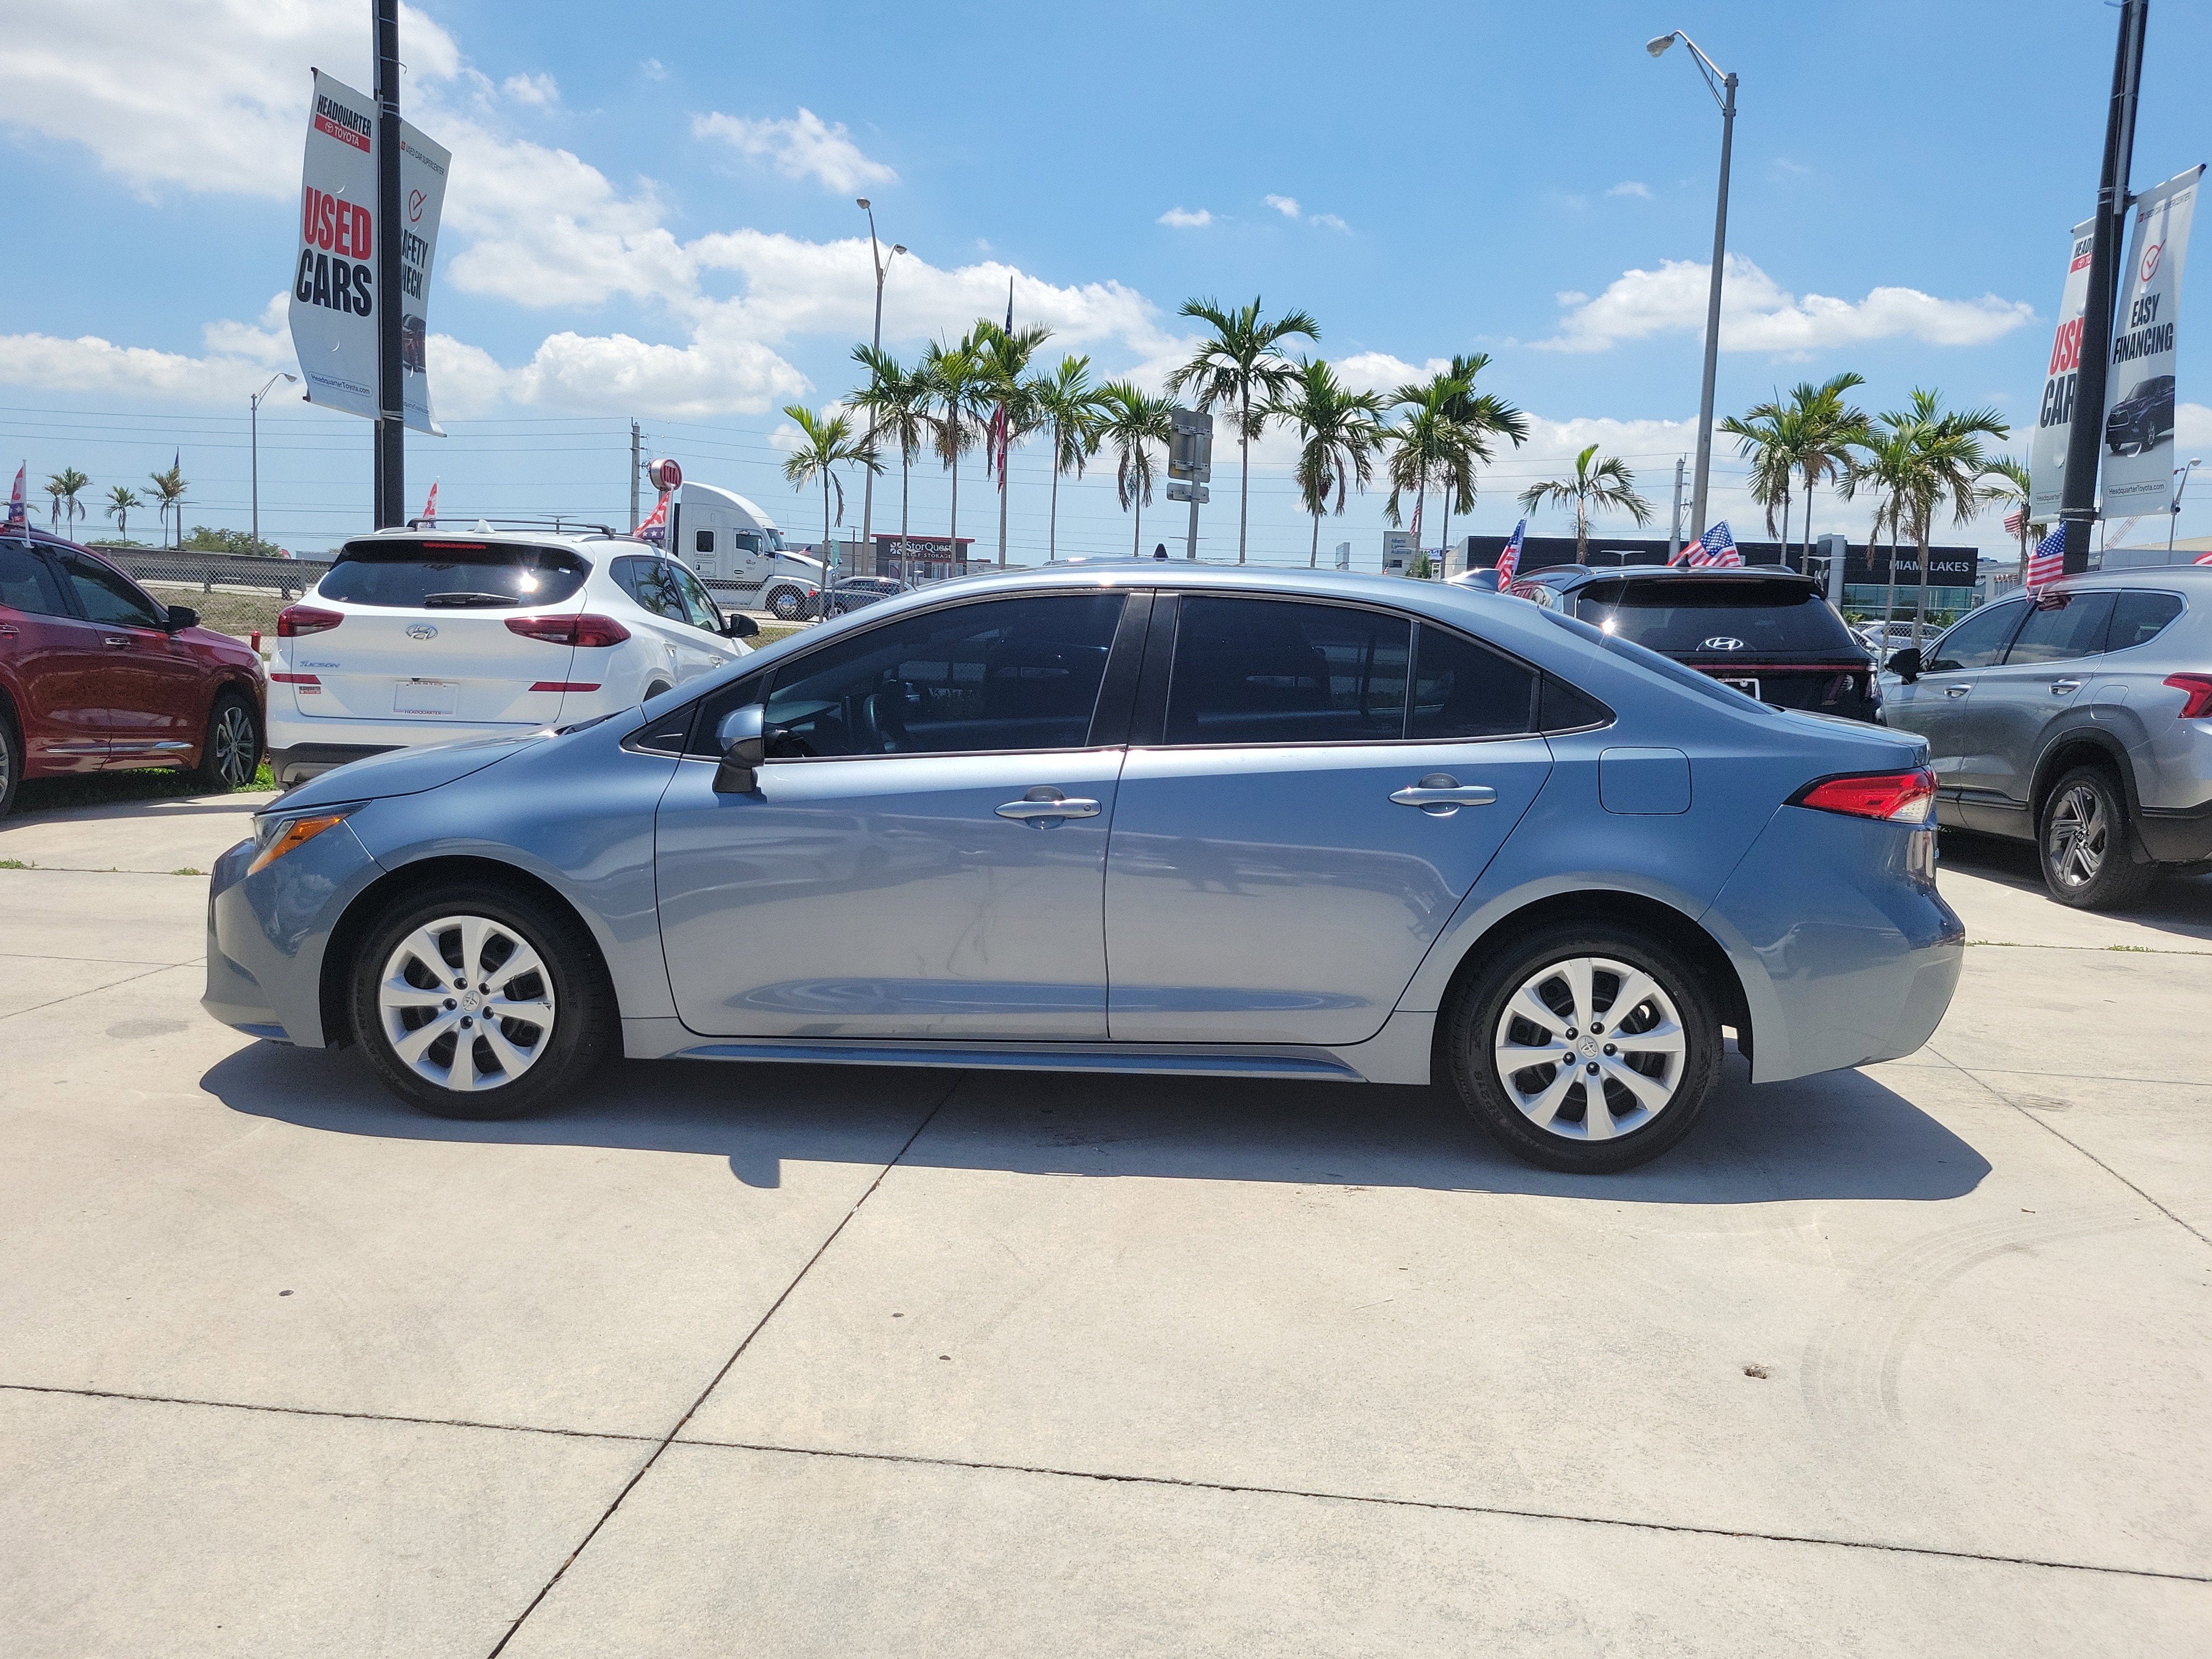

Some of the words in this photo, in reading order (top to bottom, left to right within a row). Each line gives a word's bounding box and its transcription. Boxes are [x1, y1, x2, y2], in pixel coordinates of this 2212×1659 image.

[316, 94, 372, 138] HEADQUARTER
[334, 126, 360, 147] TOYOTA
[304, 185, 373, 261] USED
[401, 227, 428, 269] AFETY
[296, 249, 373, 317] CARS
[403, 263, 423, 301] HECK
[2130, 293, 2160, 329] EASY
[2050, 317, 2084, 375] USE
[2113, 323, 2174, 365] FINANCING
[311, 374, 370, 394] HeadquarterToyota.com
[2040, 373, 2077, 428] CAR
[2109, 484, 2164, 495] HeadquarterToyota.com
[906, 541, 952, 553] StorQuest
[1929, 561, 1969, 572] LAKES
